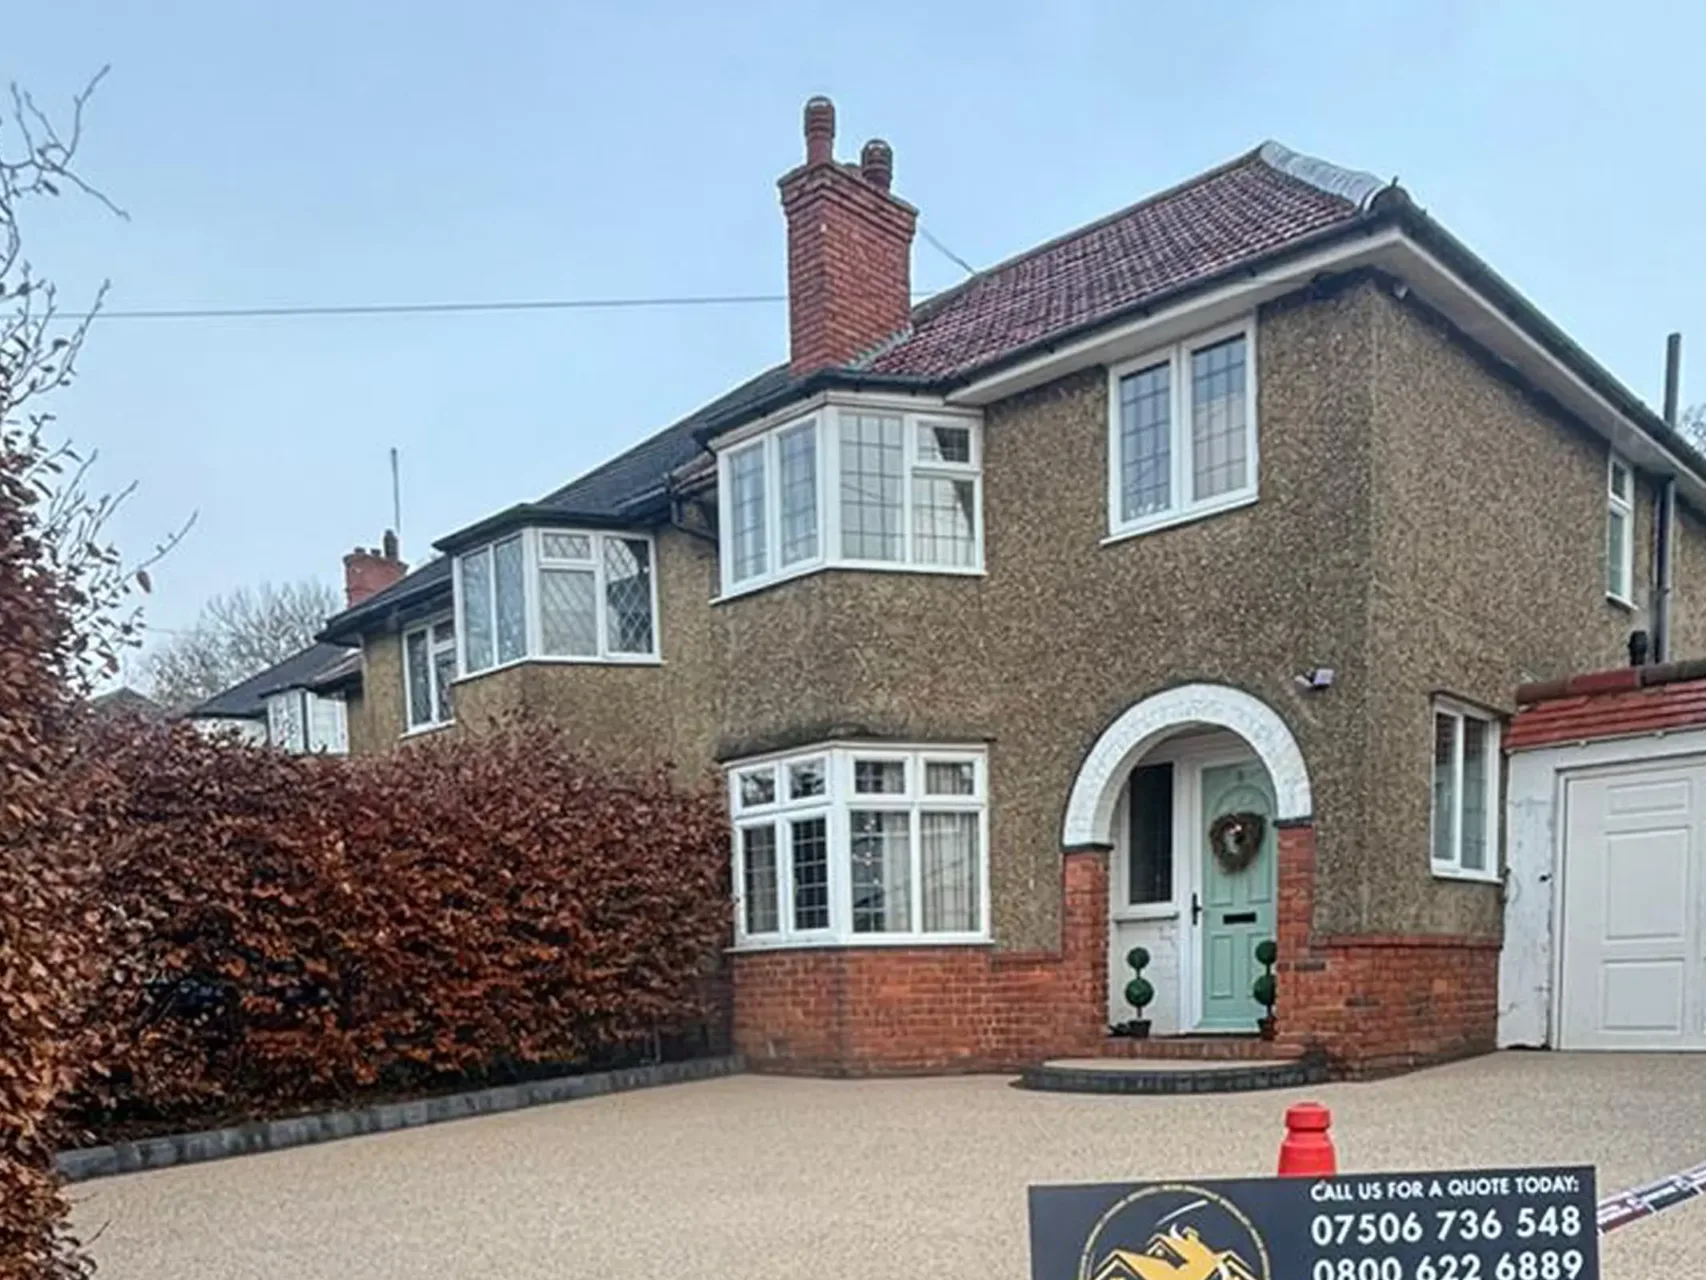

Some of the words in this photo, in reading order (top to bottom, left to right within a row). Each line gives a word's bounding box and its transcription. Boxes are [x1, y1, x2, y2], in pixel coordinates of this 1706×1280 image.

[1310, 1180, 1352, 1200] CALL
[1358, 1180, 1382, 1199] US
[1388, 1179, 1424, 1199] FOR
[1429, 1180, 1443, 1197] A
[1448, 1177, 1510, 1197] QUOTE
[1515, 1175, 1580, 1194] TODAY:
[1311, 1212, 1423, 1246] 07506
[1436, 1209, 1502, 1241] 736
[1515, 1205, 1581, 1238] 548
